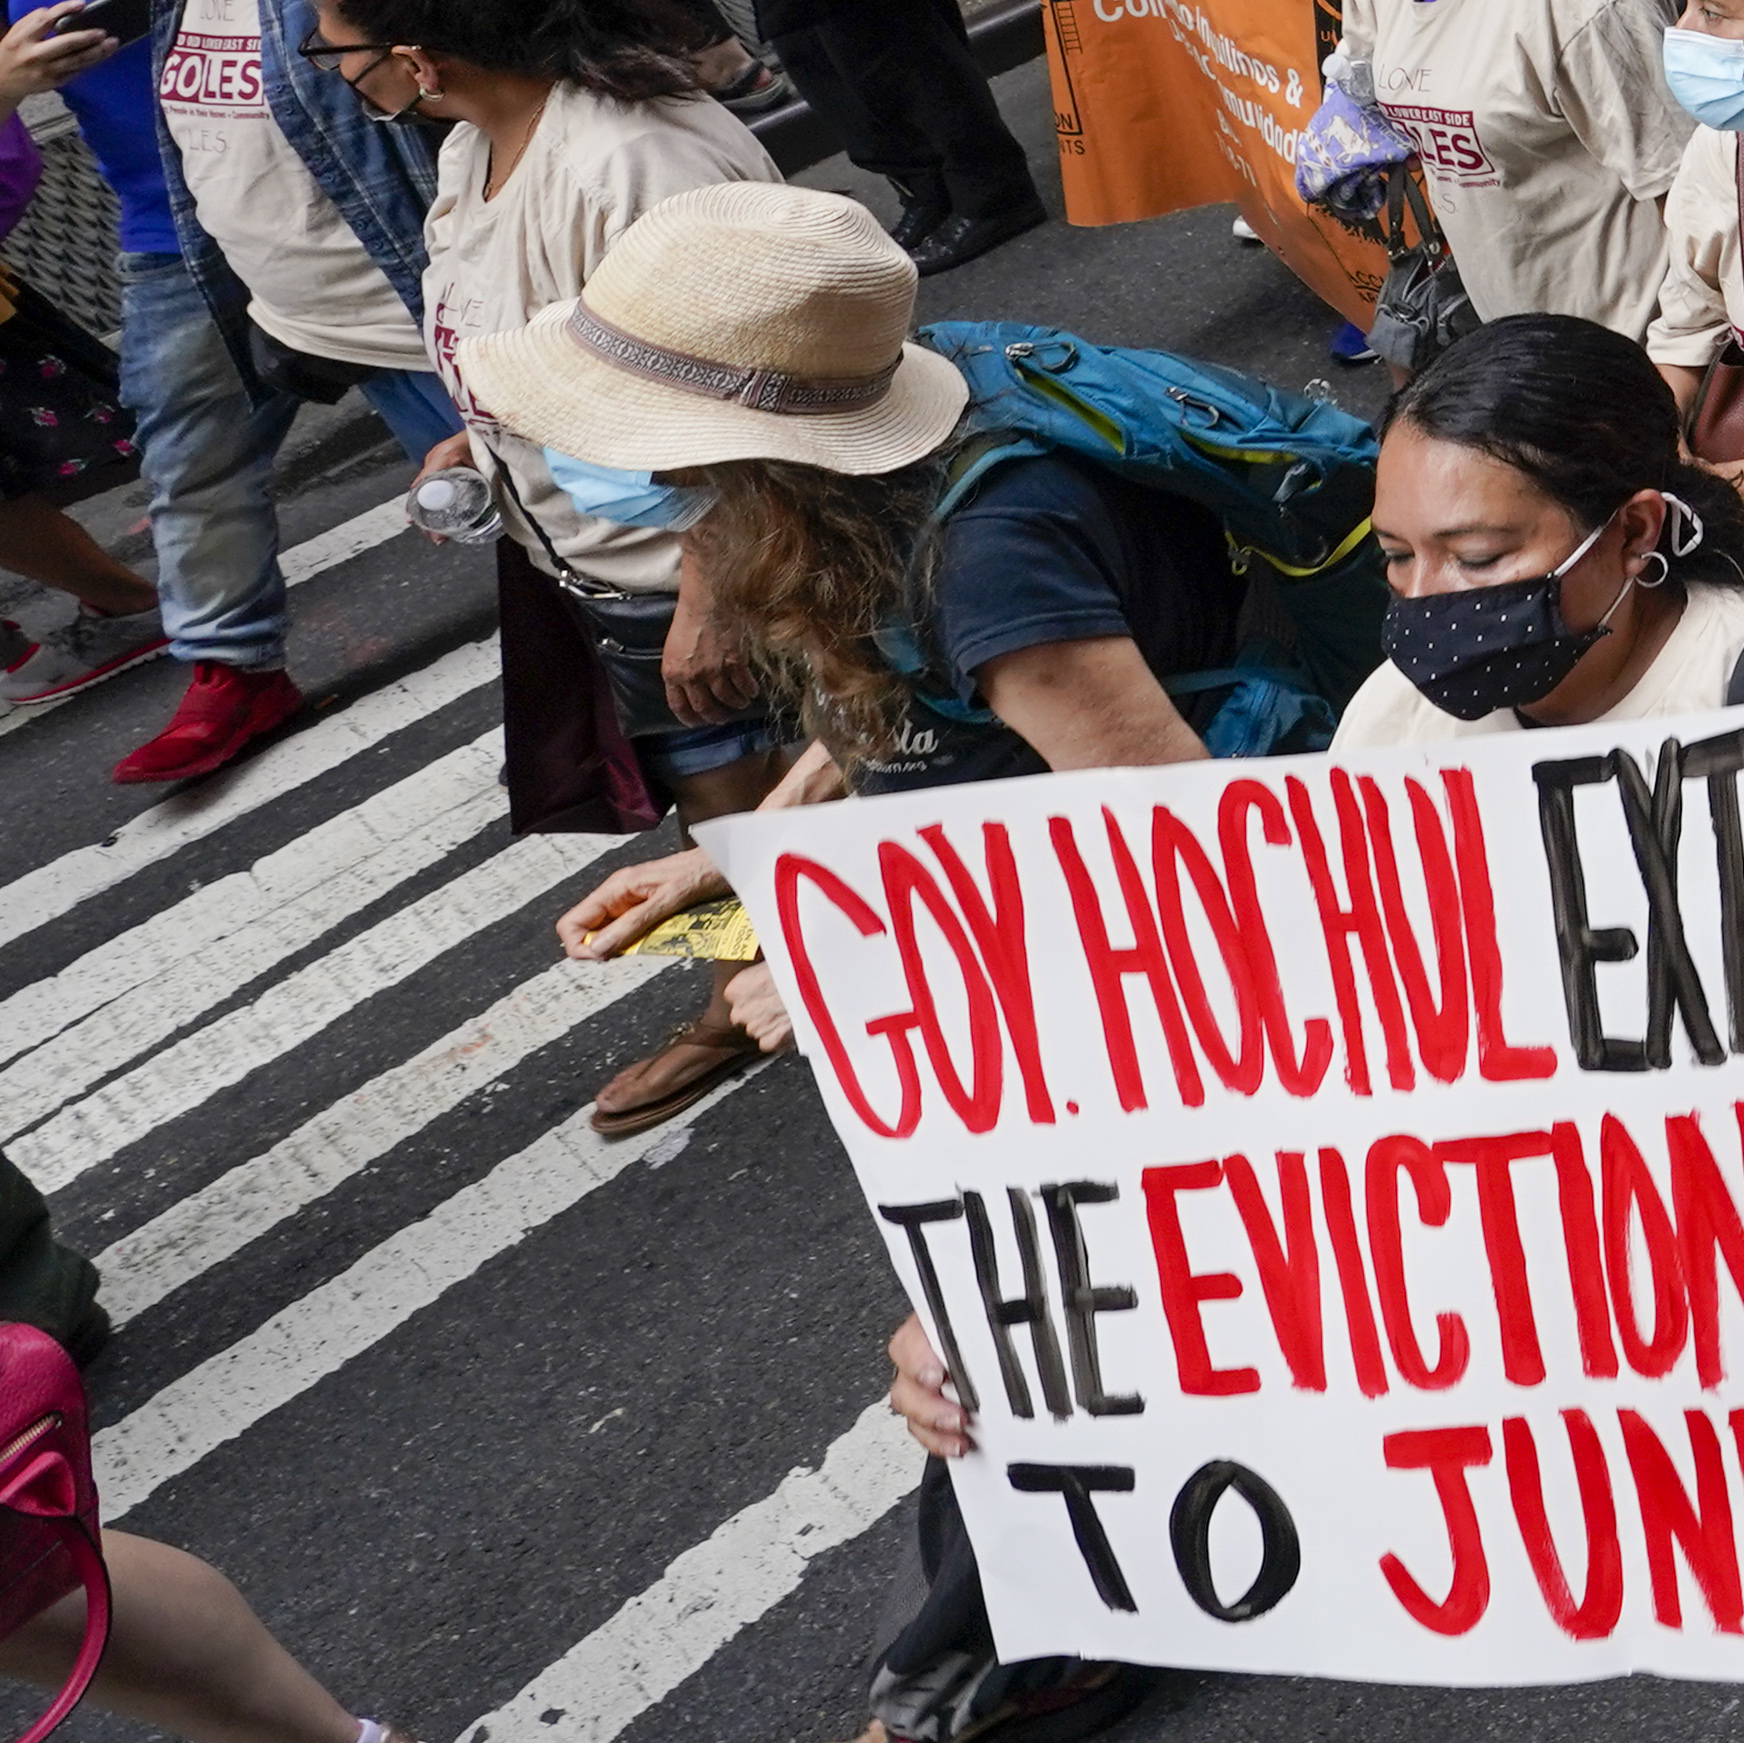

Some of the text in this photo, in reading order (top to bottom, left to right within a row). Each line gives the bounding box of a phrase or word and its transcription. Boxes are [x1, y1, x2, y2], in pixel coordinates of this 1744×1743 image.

[159, 54, 262, 101] GOLES
[1285, 68, 1304, 109] &
[1379, 63, 1432, 92] LOVE
[1422, 109, 1444, 124] EAST
[1444, 112, 1471, 127] SIDE
[1045, 762, 1559, 1114] HOCHUL
[879, 1176, 1146, 1423] THE
[1006, 1457, 1304, 1626] TO
